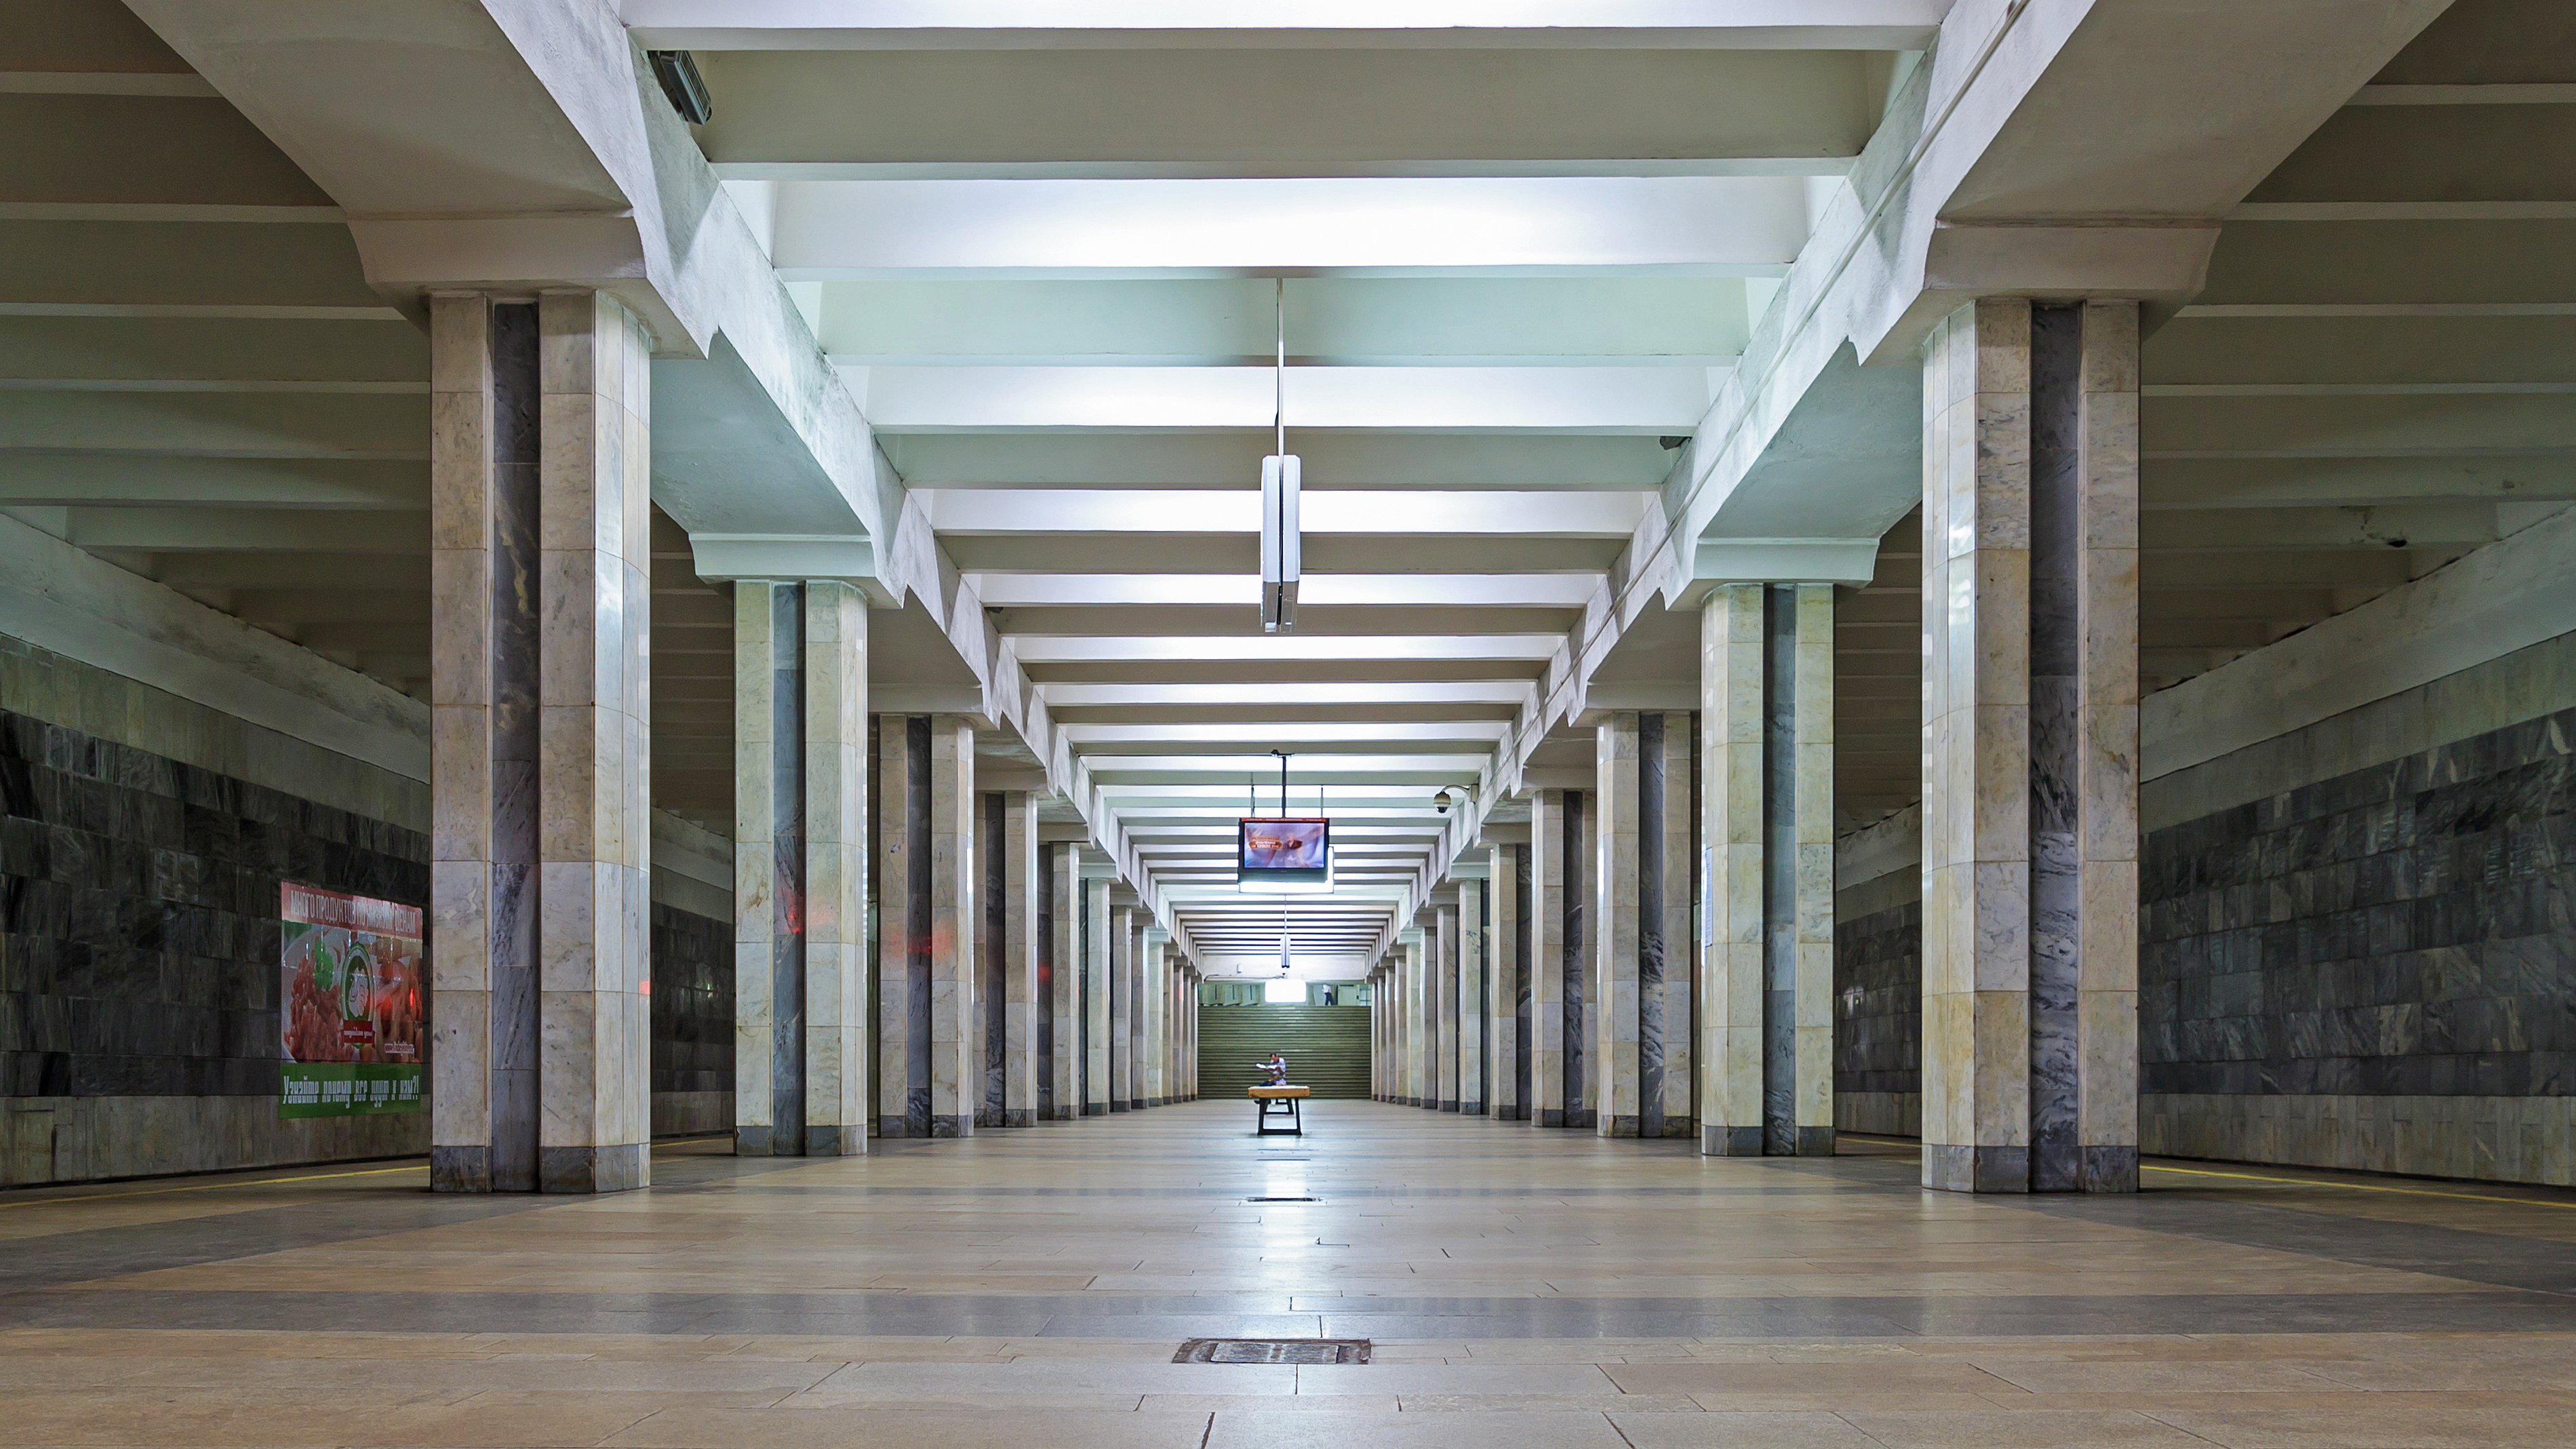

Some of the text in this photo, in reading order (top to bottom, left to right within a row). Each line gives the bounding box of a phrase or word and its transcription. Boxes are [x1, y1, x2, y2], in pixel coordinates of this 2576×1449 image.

[291, 890, 315, 918] МНОГО
[315, 894, 355, 924] ПРОДУКТОВ
[283, 1075, 319, 1105] Узнайте
[322, 1081, 351, 1109] почему
[354, 1081, 368, 1102] все
